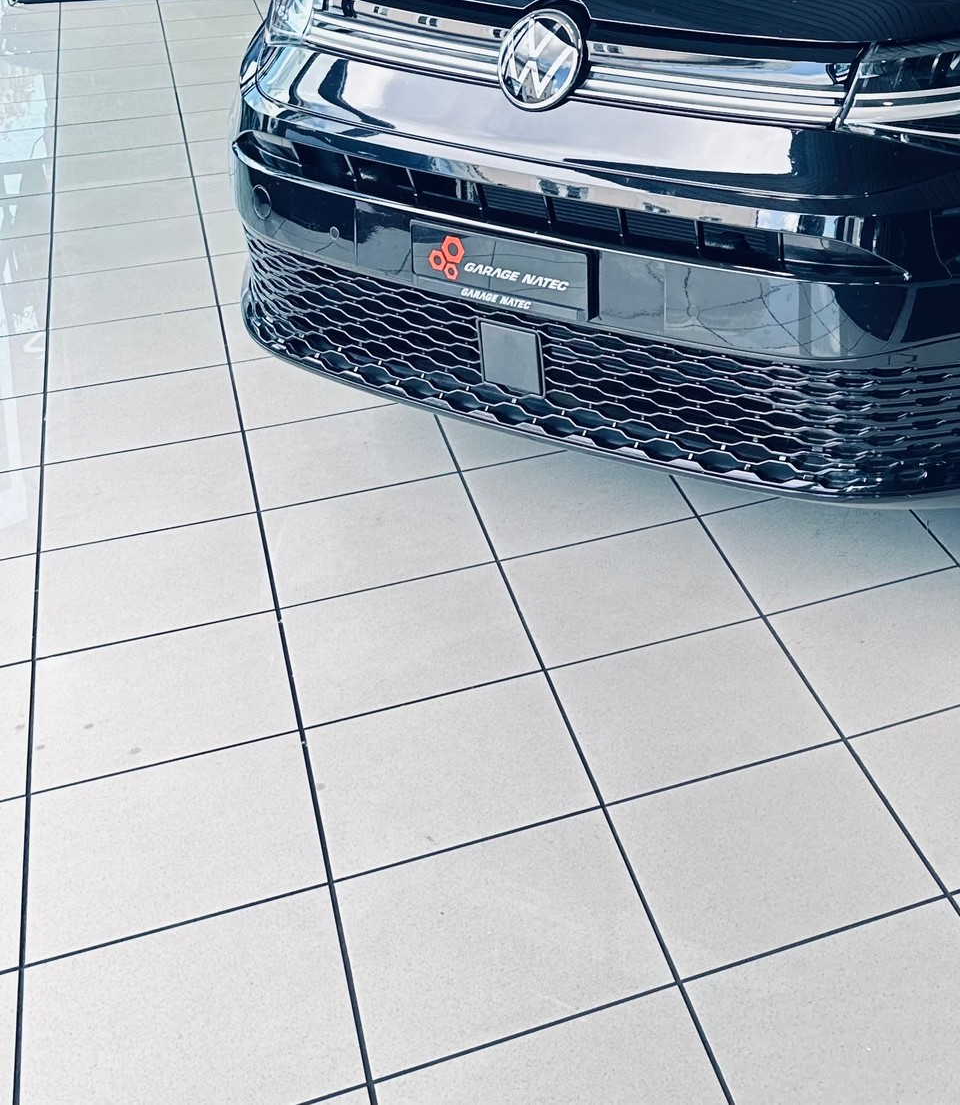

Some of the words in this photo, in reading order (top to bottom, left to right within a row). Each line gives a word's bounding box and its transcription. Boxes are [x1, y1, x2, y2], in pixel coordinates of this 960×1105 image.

[464, 262, 520, 281] GARAGE
[521, 273, 570, 291] NATEC
[461, 288, 499, 302] GARAGE
[499, 295, 532, 310] NATEC
